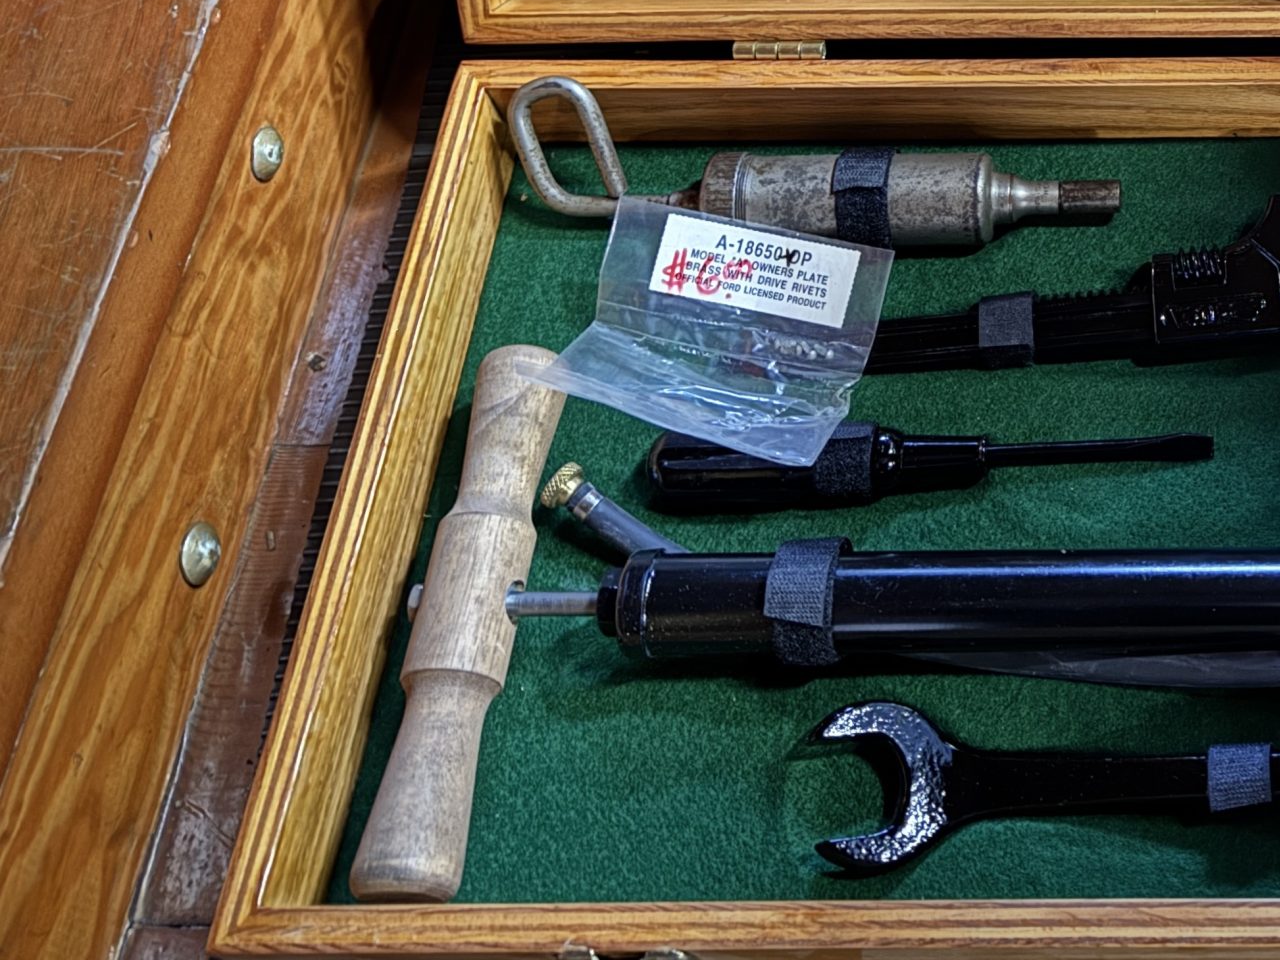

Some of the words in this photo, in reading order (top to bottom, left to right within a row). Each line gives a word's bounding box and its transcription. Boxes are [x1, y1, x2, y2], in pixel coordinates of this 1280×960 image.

[690, 248, 727, 265] MODEL
[752, 260, 794, 279] OWNERS
[796, 269, 829, 286] PLATE
[715, 234, 813, 268] A-18650OP
[675, 272, 714, 288] OFFICIAL
[719, 280, 742, 293] FORD
[743, 285, 785, 302] LICENSED
[786, 294, 828, 311] PRODUCT
[685, 260, 722, 277] BRASS
[727, 269, 754, 283] WITH
[757, 274, 788, 290] DRIVE
[791, 282, 828, 298] RIVETS
